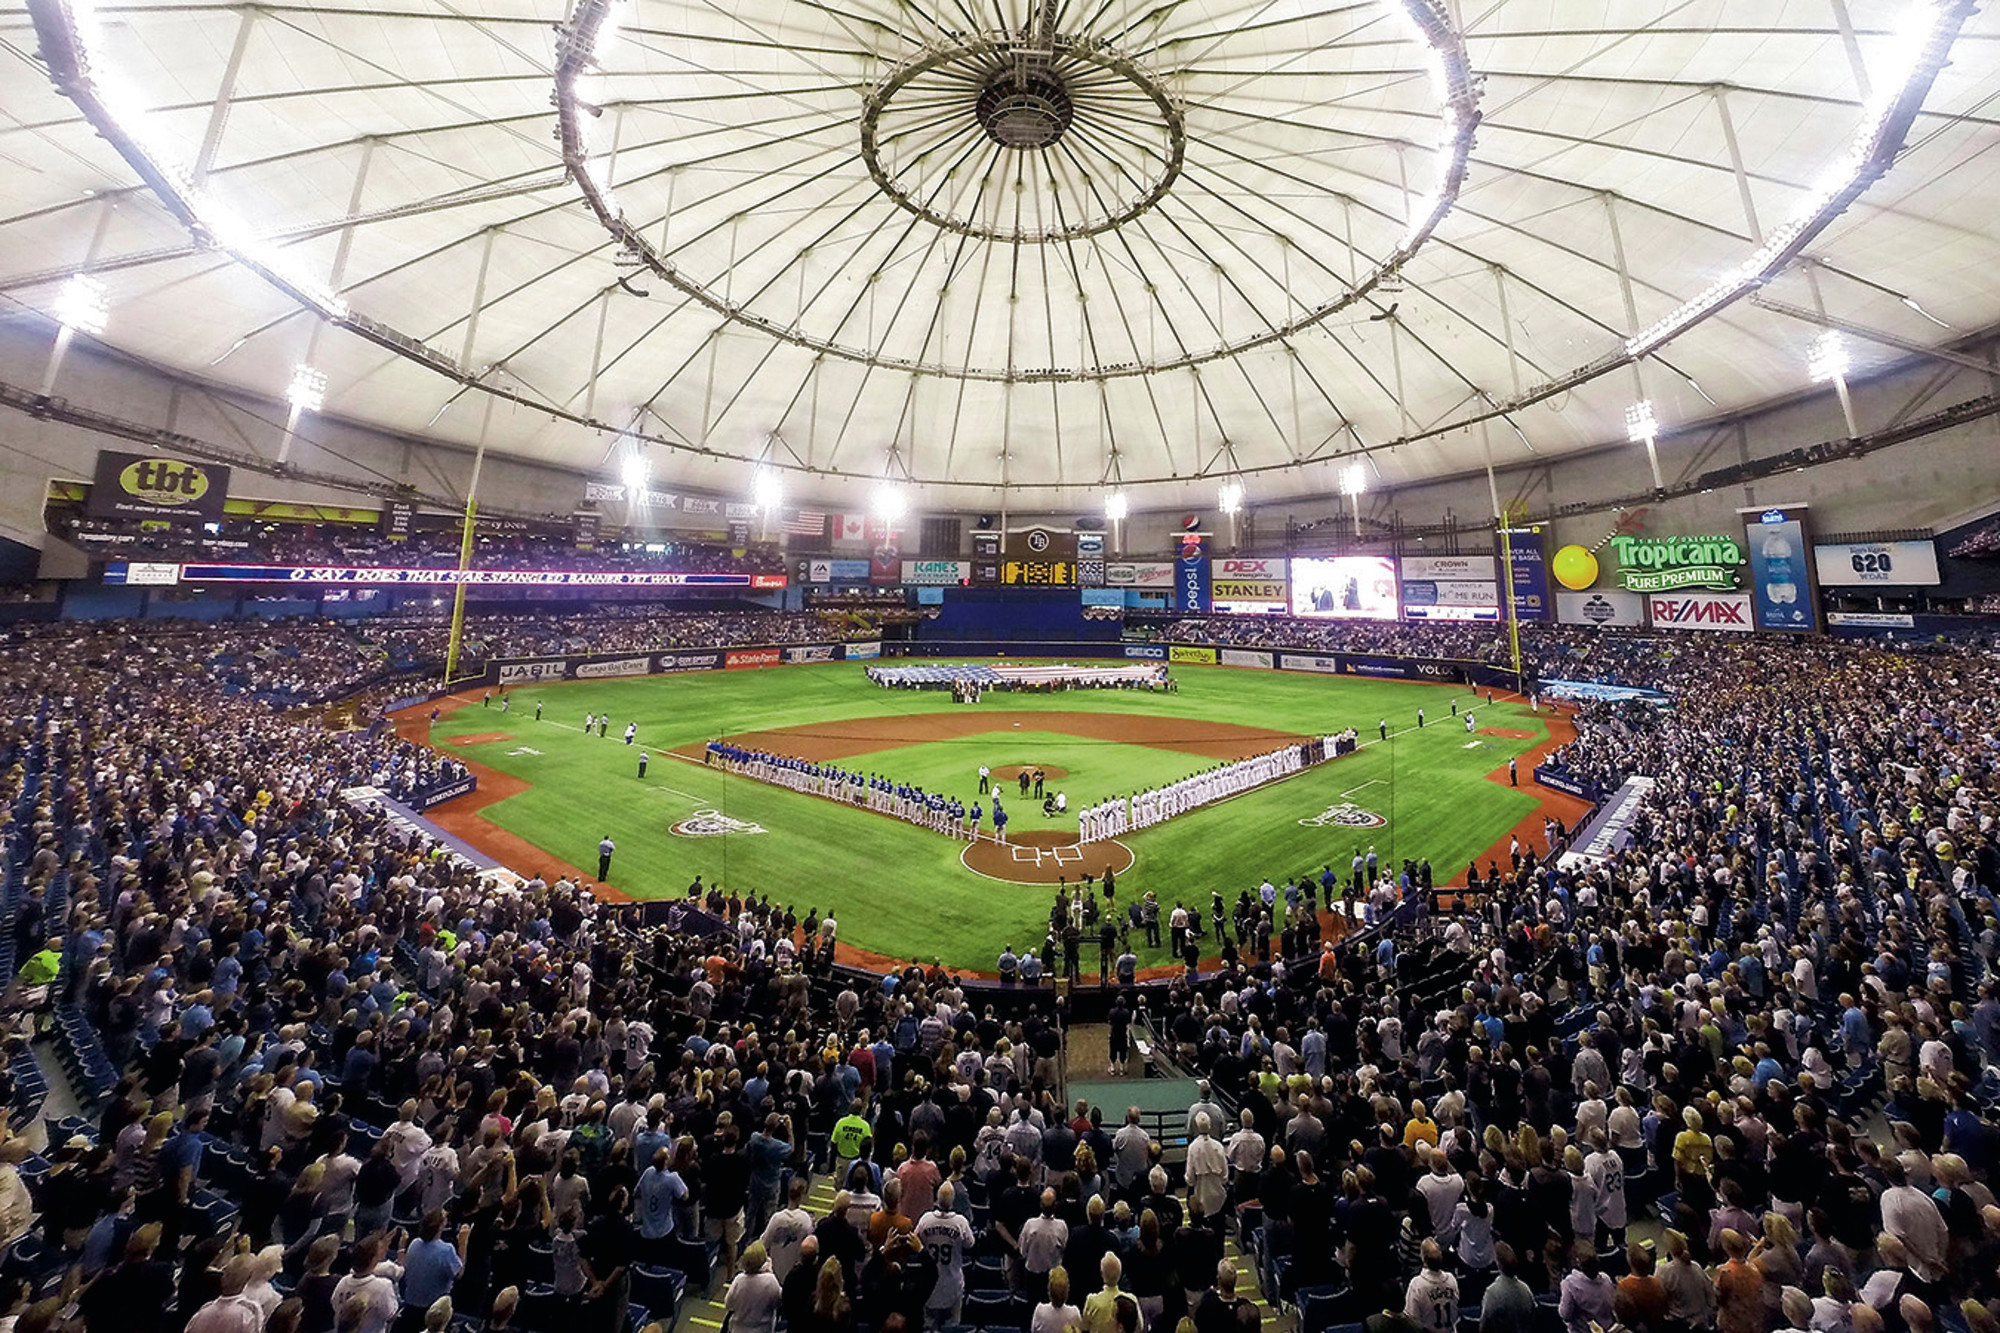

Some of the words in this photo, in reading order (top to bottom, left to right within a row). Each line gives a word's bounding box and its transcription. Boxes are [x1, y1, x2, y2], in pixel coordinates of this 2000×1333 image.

[134, 462, 198, 494] tbt
[1610, 535, 1740, 569] Tropicana
[1078, 561, 1104, 574] ROSE
[1223, 560, 1268, 572] DEX
[1433, 560, 1469, 568] CROWN
[1851, 553, 1893, 573] 620
[290, 569, 306, 580] O
[353, 570, 401, 581] DOES
[406, 572, 444, 583] THAT
[568, 573, 622, 583] BANNER
[626, 574, 648, 583] YET
[651, 573, 686, 584] WAVE
[1108, 570, 1133, 578] HESS
[1626, 575, 1660, 588] PURE
[1662, 569, 1724, 586] PREMIUM
[1184, 568, 1200, 611] pepsi
[1214, 584, 1283, 596] STANLEY
[1472, 592, 1494, 601] RUN
[1652, 599, 1746, 625] RE/MAX
[1125, 646, 1164, 657] GEICO
[501, 664, 564, 679] JABIL
[629, 1034, 637, 1049] 8
[964, 1065, 972, 1077] 9
[1605, 1171, 1621, 1193] 23
[650, 1195, 658, 1212] 8
[1434, 1301, 1453, 1329] 11
